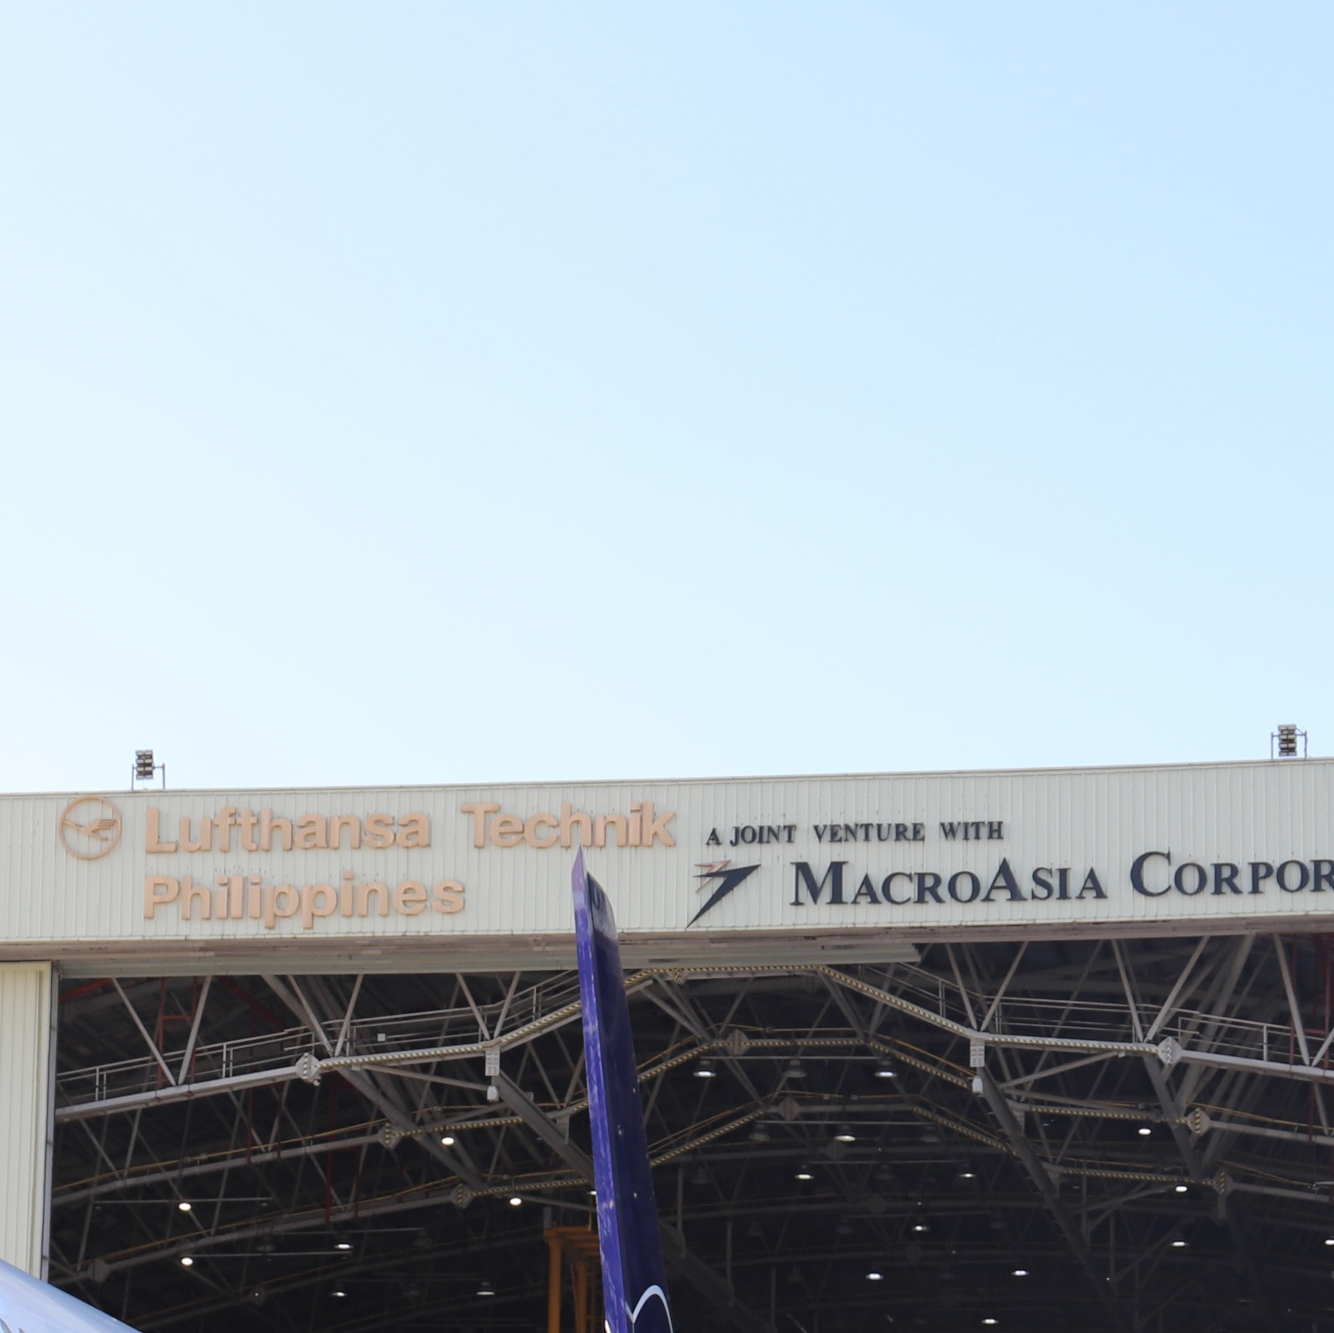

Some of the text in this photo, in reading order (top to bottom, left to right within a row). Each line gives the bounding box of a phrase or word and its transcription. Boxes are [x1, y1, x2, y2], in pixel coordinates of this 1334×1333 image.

[145, 801, 677, 854] Lufthansa Technik
[705, 821, 1004, 847] A JOINT VENTURE WITH
[143, 871, 465, 930] Philippines
